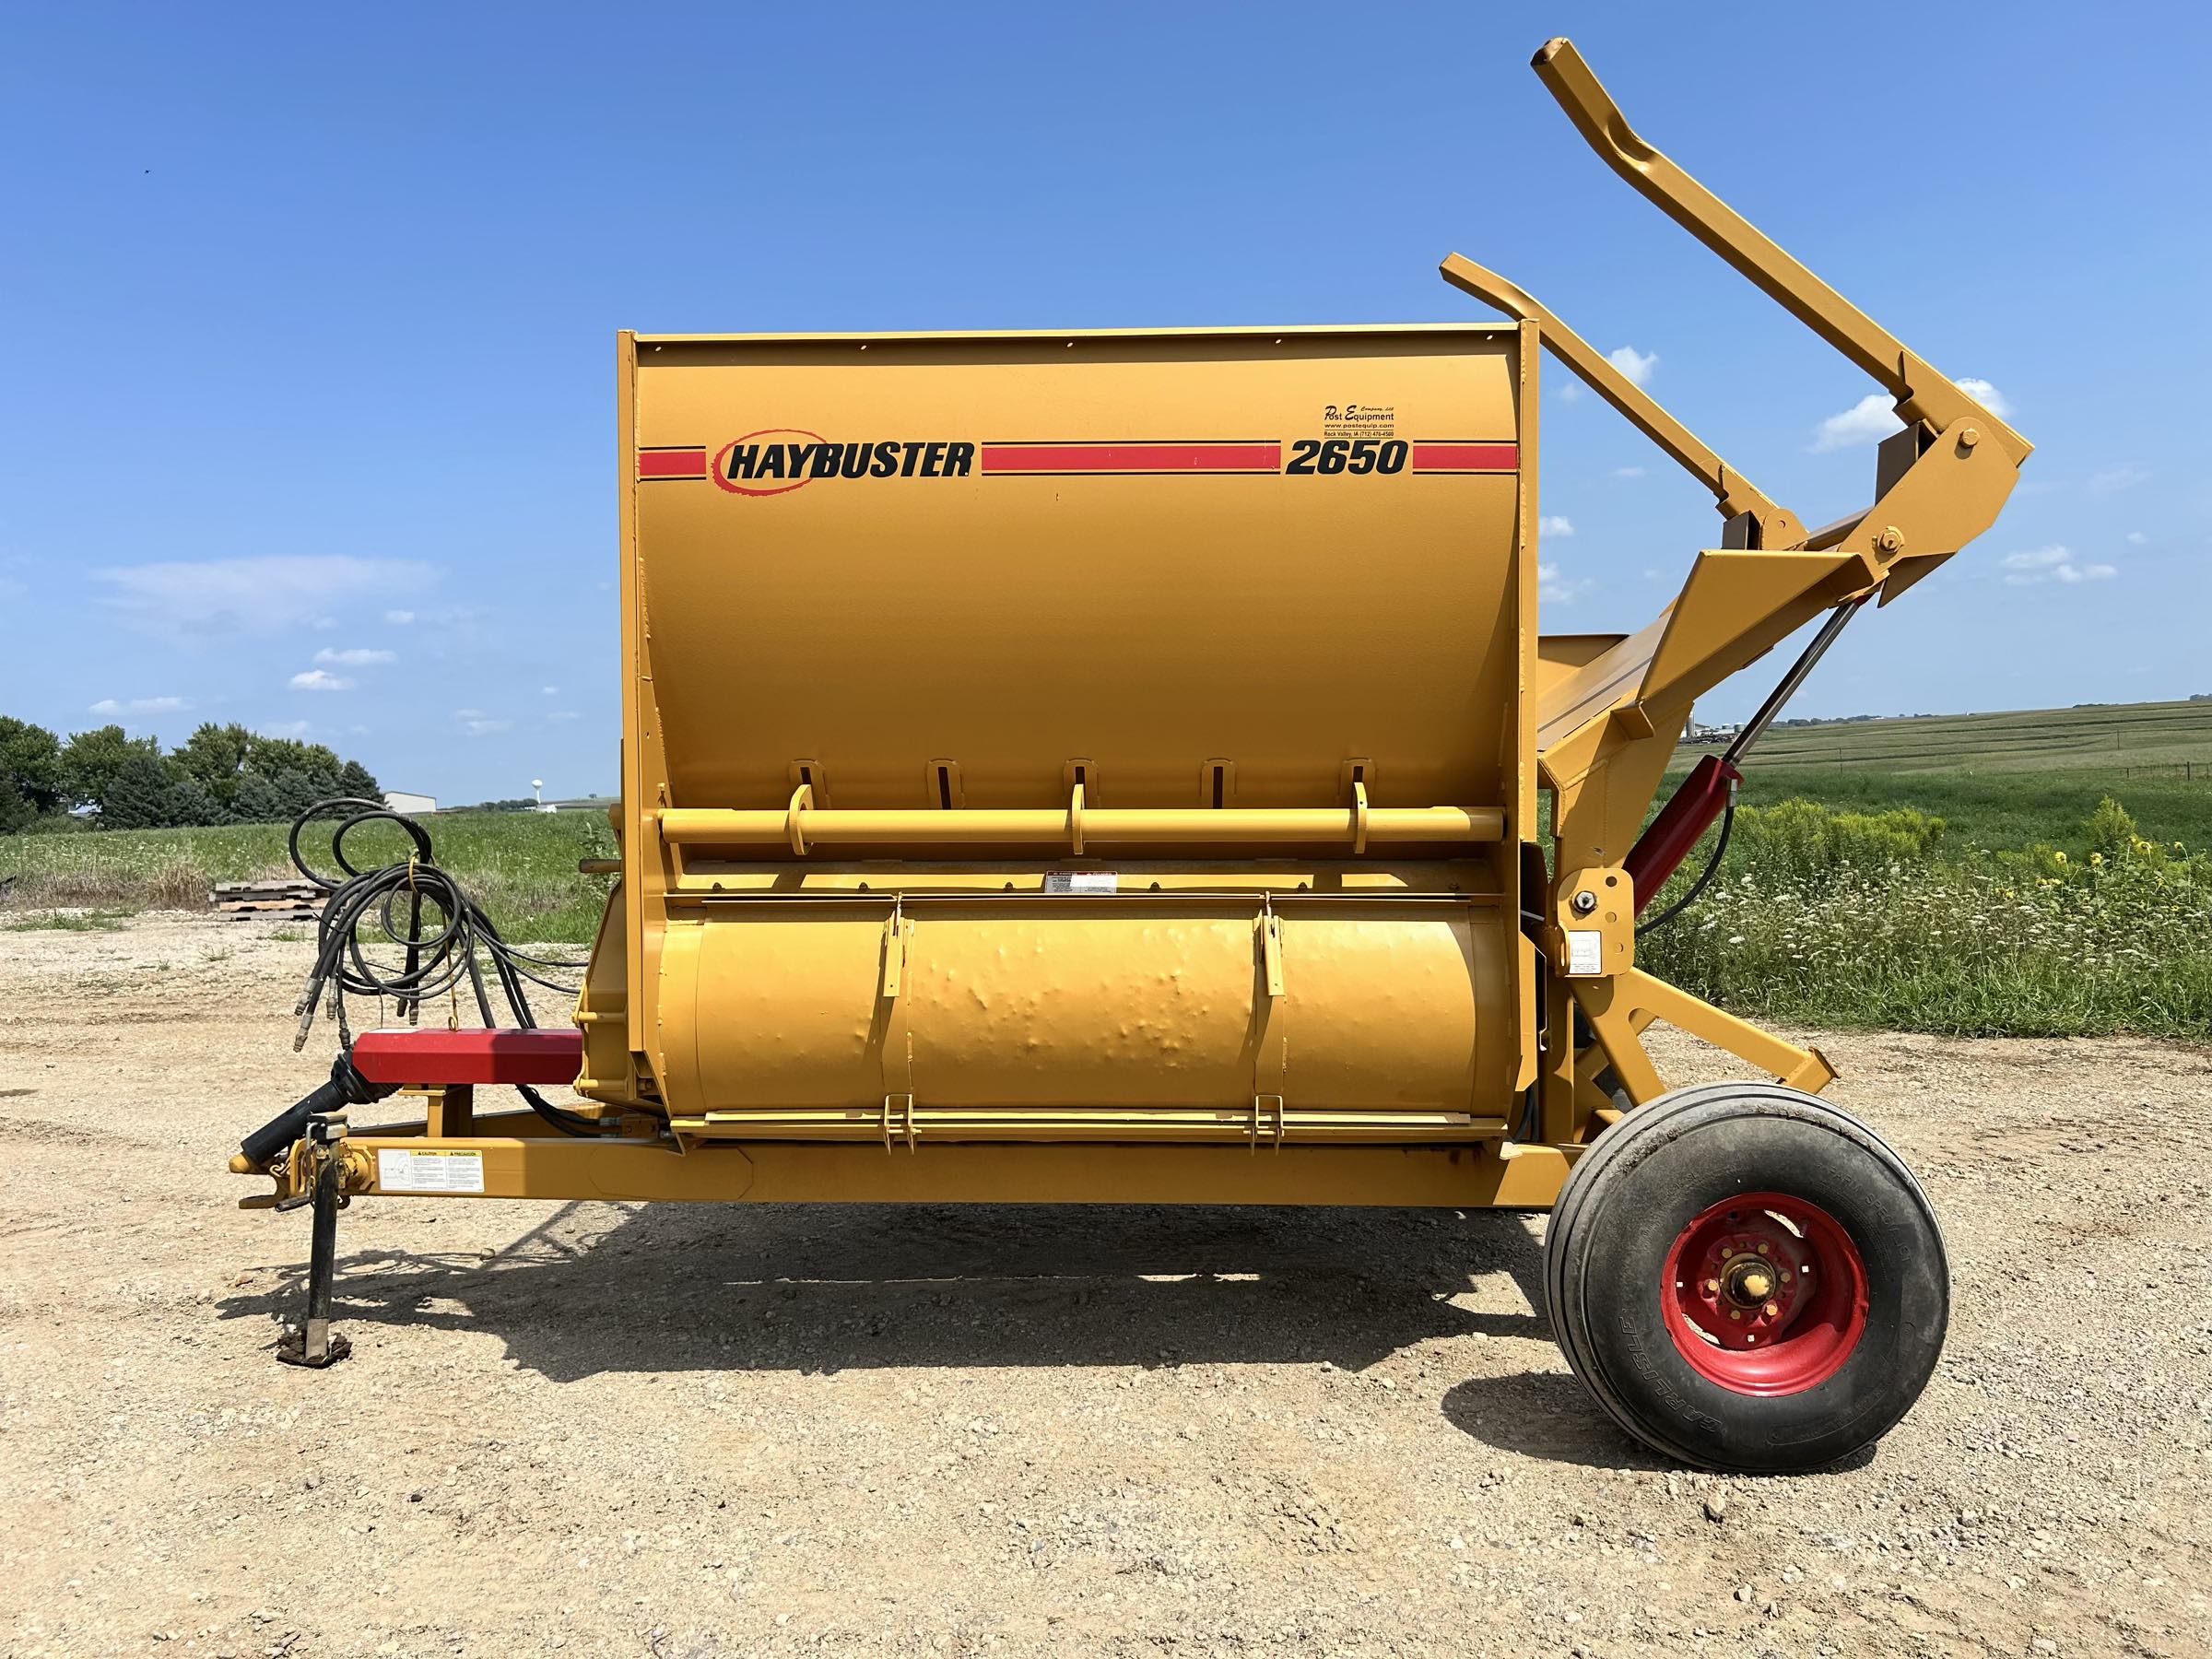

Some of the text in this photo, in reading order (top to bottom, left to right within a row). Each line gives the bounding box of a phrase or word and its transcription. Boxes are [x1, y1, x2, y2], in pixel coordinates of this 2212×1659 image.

[1324, 405, 1394, 422] Post Equipment
[726, 441, 975, 479] HAYBUSTER
[1285, 440, 1408, 475] 2650
[1618, 1316, 1724, 1432] CARLISLE
